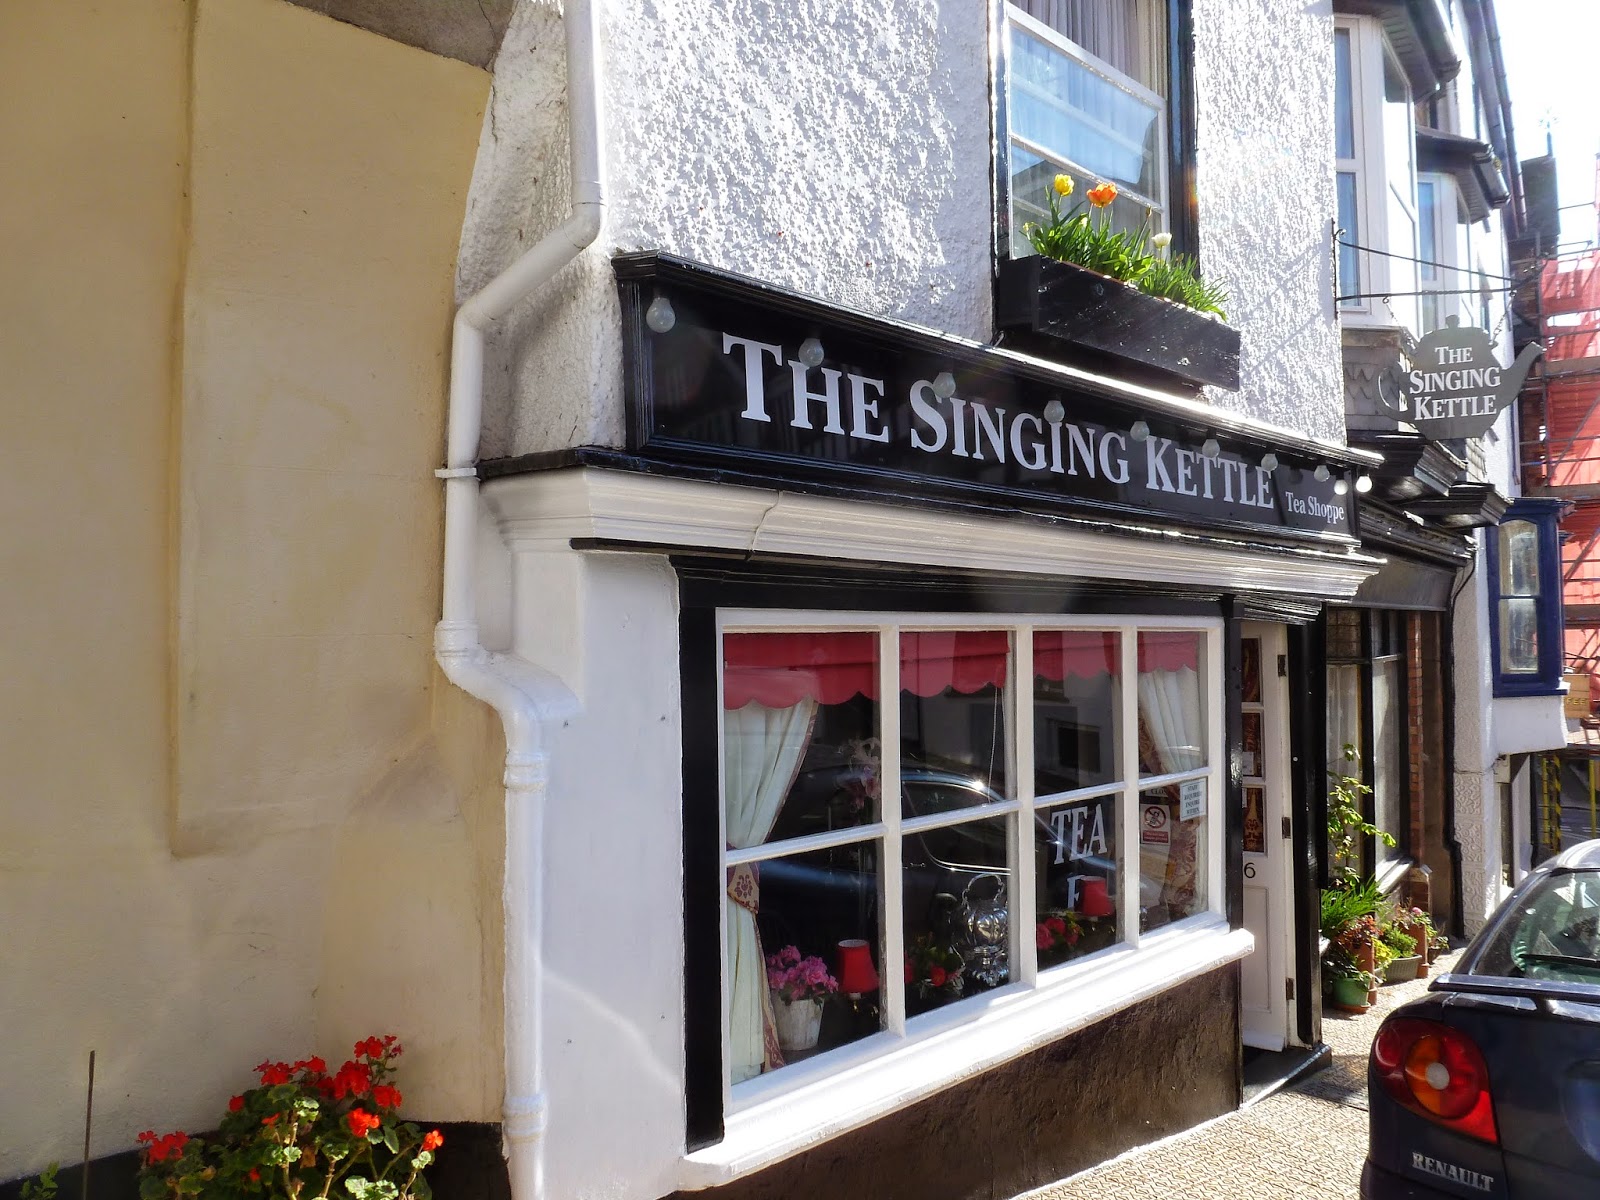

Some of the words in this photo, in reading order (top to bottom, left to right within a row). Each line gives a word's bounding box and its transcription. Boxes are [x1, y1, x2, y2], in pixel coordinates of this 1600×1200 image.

[1435, 347, 1473, 365] THE
[1409, 367, 1501, 394] SINGING
[723, 332, 889, 443] THE
[910, 379, 1130, 484] SINGING
[1145, 435, 1274, 509] KETTLE
[1414, 395, 1497, 421] KETTLE
[1285, 491, 1306, 515] Tea
[1307, 495, 1345, 525] Shoppe
[1051, 804, 1107, 865] TEA
[1243, 862, 1256, 879] 6
[1412, 1152, 1494, 1192] RENAULT
